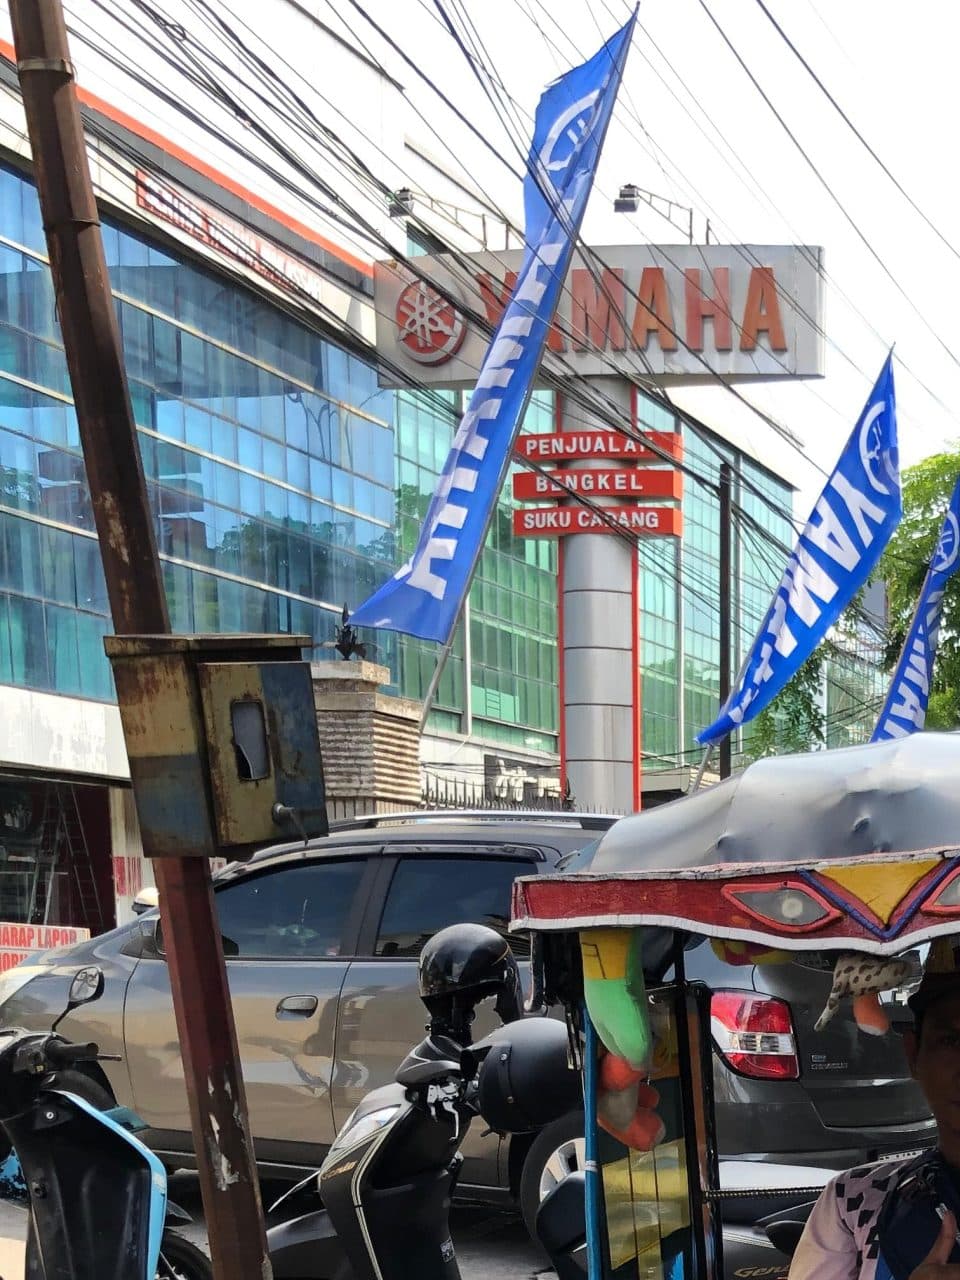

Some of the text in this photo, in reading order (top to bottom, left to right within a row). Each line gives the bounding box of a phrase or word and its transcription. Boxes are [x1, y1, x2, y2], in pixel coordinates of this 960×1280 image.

[476, 267, 788, 352] YMAHA
[526, 436, 654, 455] PENJUALA
[536, 474, 643, 492] BENGKEL
[524, 512, 571, 529] SUKU
[0, 926, 34, 948] ARAP
